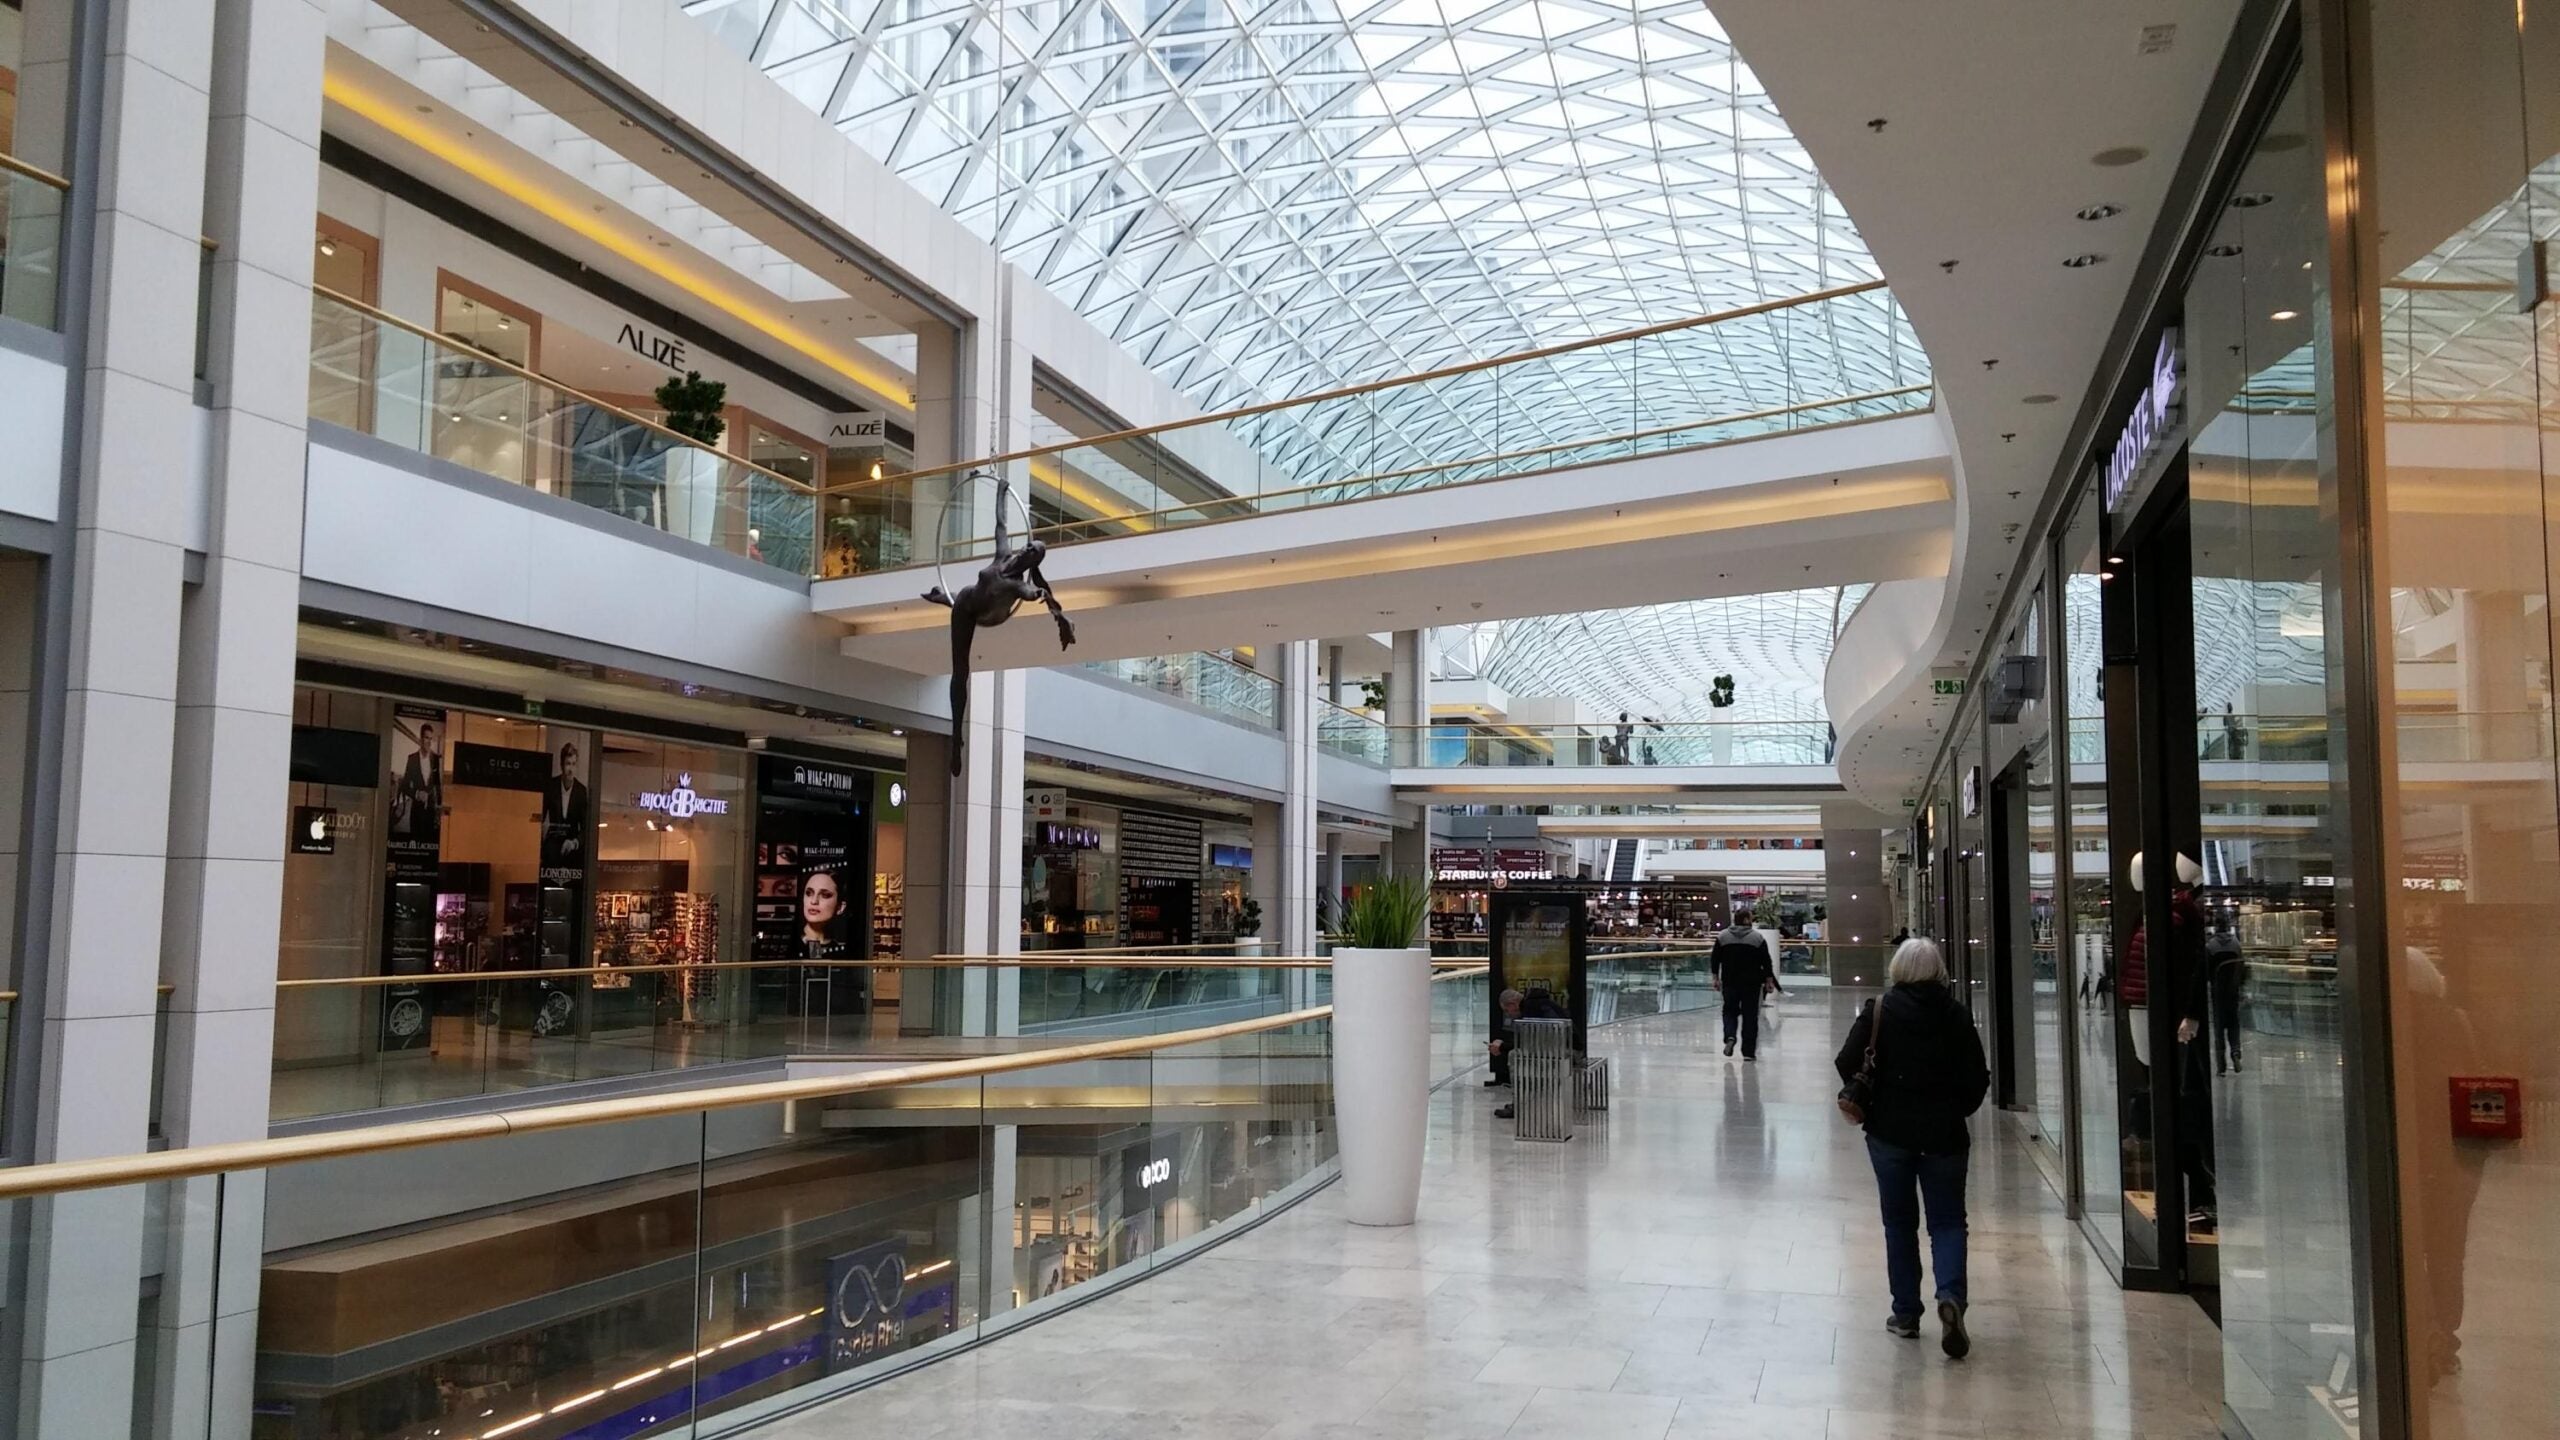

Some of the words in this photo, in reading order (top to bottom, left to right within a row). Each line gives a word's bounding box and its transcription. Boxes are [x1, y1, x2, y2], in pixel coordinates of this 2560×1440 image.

[2105, 387, 2150, 514] LACOSTE
[640, 792, 671, 811] BIJOU
[1049, 825, 1098, 847] MOLOKO
[540, 867, 582, 879] LONGINES
[1439, 870, 1507, 880] STARBUCKS
[1508, 870, 1552, 880] COFFEE
